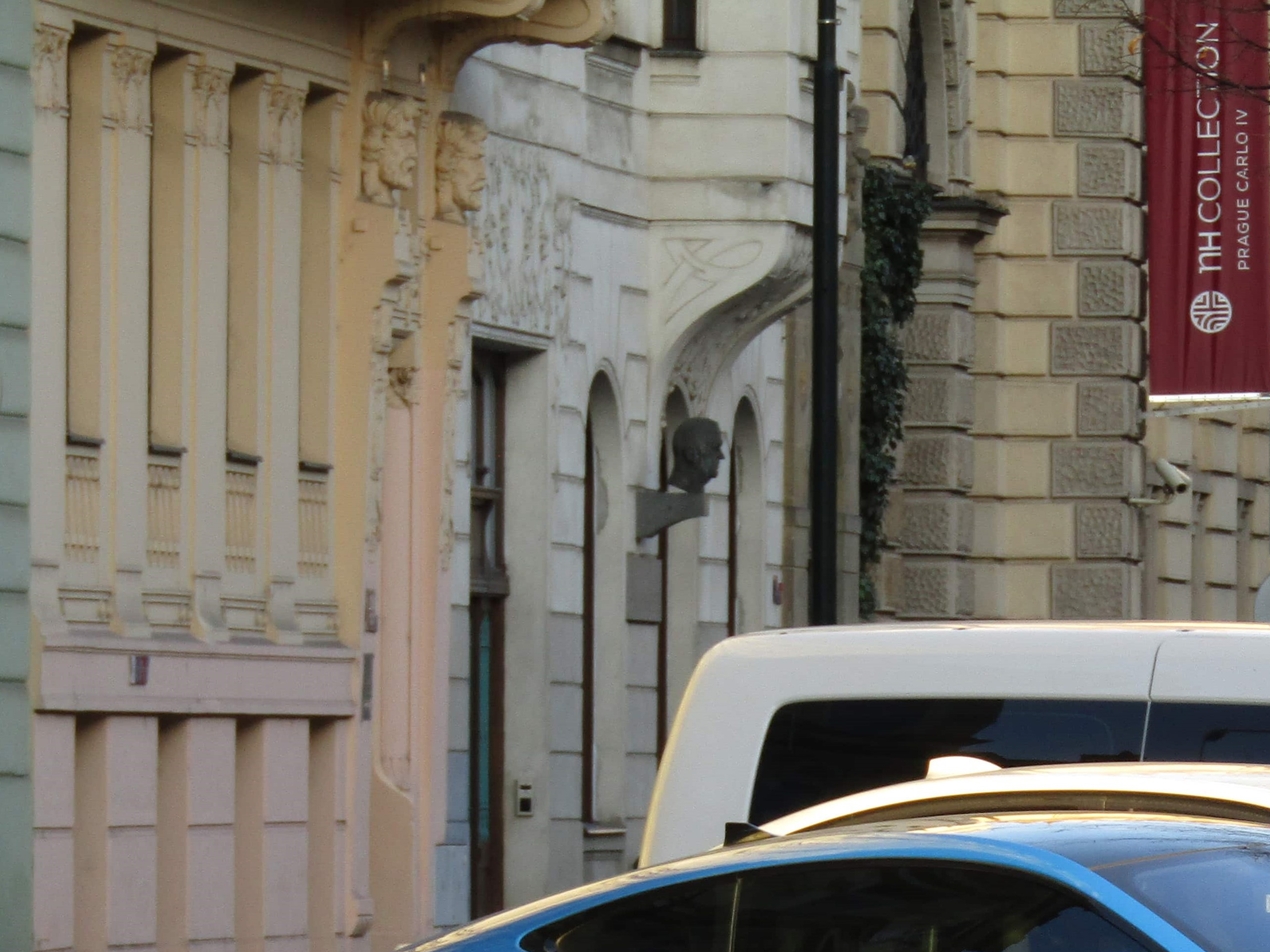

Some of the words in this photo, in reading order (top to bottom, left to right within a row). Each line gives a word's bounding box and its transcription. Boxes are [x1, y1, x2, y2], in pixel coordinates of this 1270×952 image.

[1195, 22, 1221, 223] COLLECTION
[1235, 109, 1248, 125] IV
[1235, 132, 1249, 192] CARLO
[1236, 198, 1250, 271] PRAGUE
